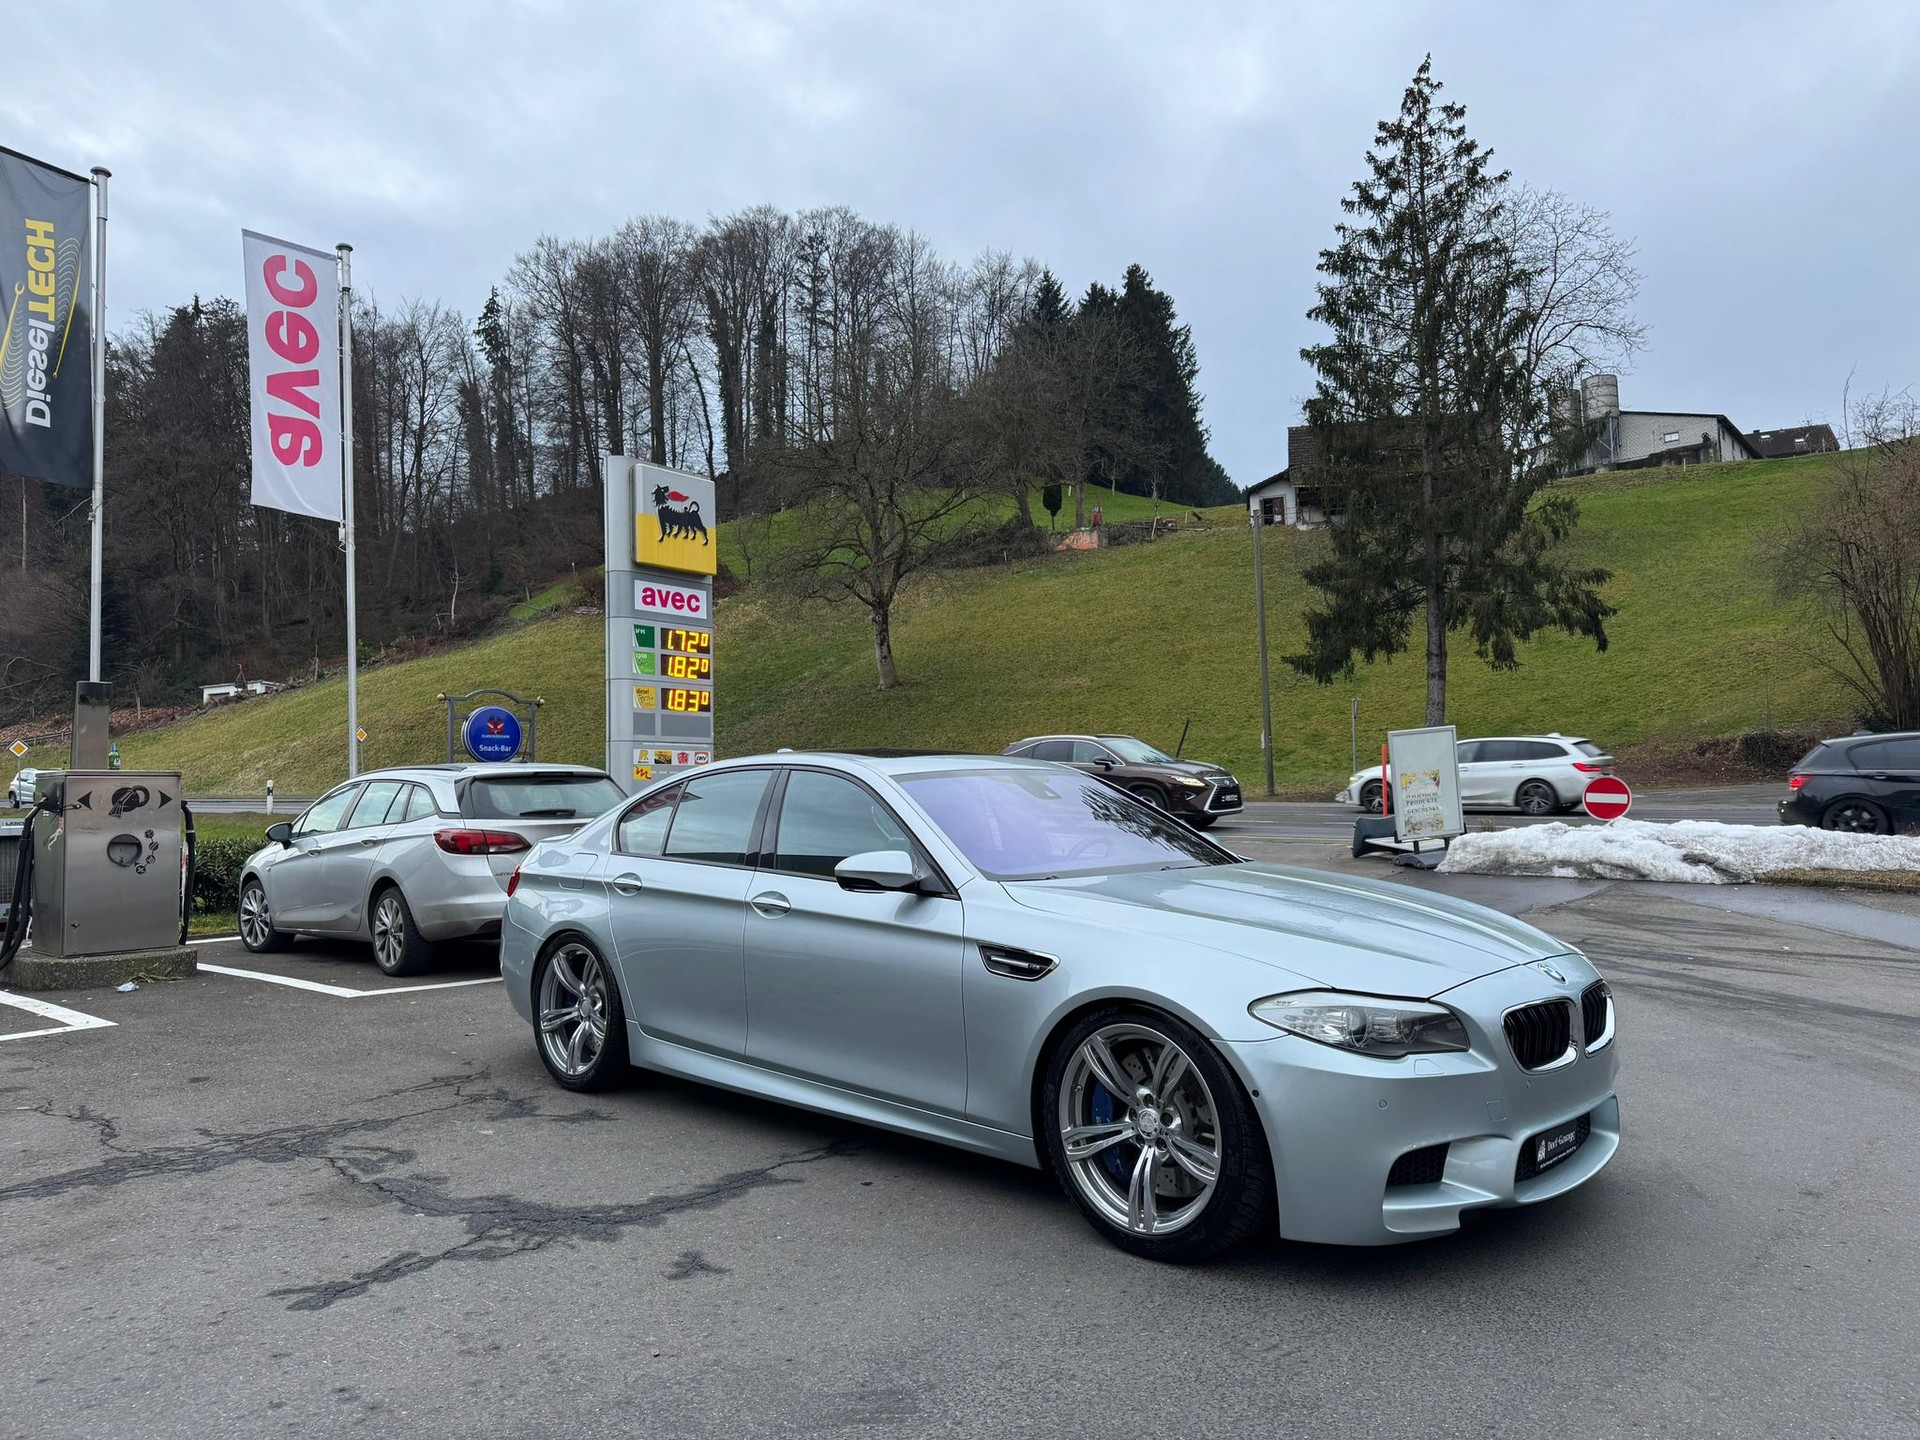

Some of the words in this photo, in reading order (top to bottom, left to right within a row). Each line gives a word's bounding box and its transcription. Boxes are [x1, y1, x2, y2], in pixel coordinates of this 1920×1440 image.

[641, 586, 701, 613] avec
[478, 744, 512, 752] Snack-Bar
[1406, 798, 1438, 806] PRODUKTE
